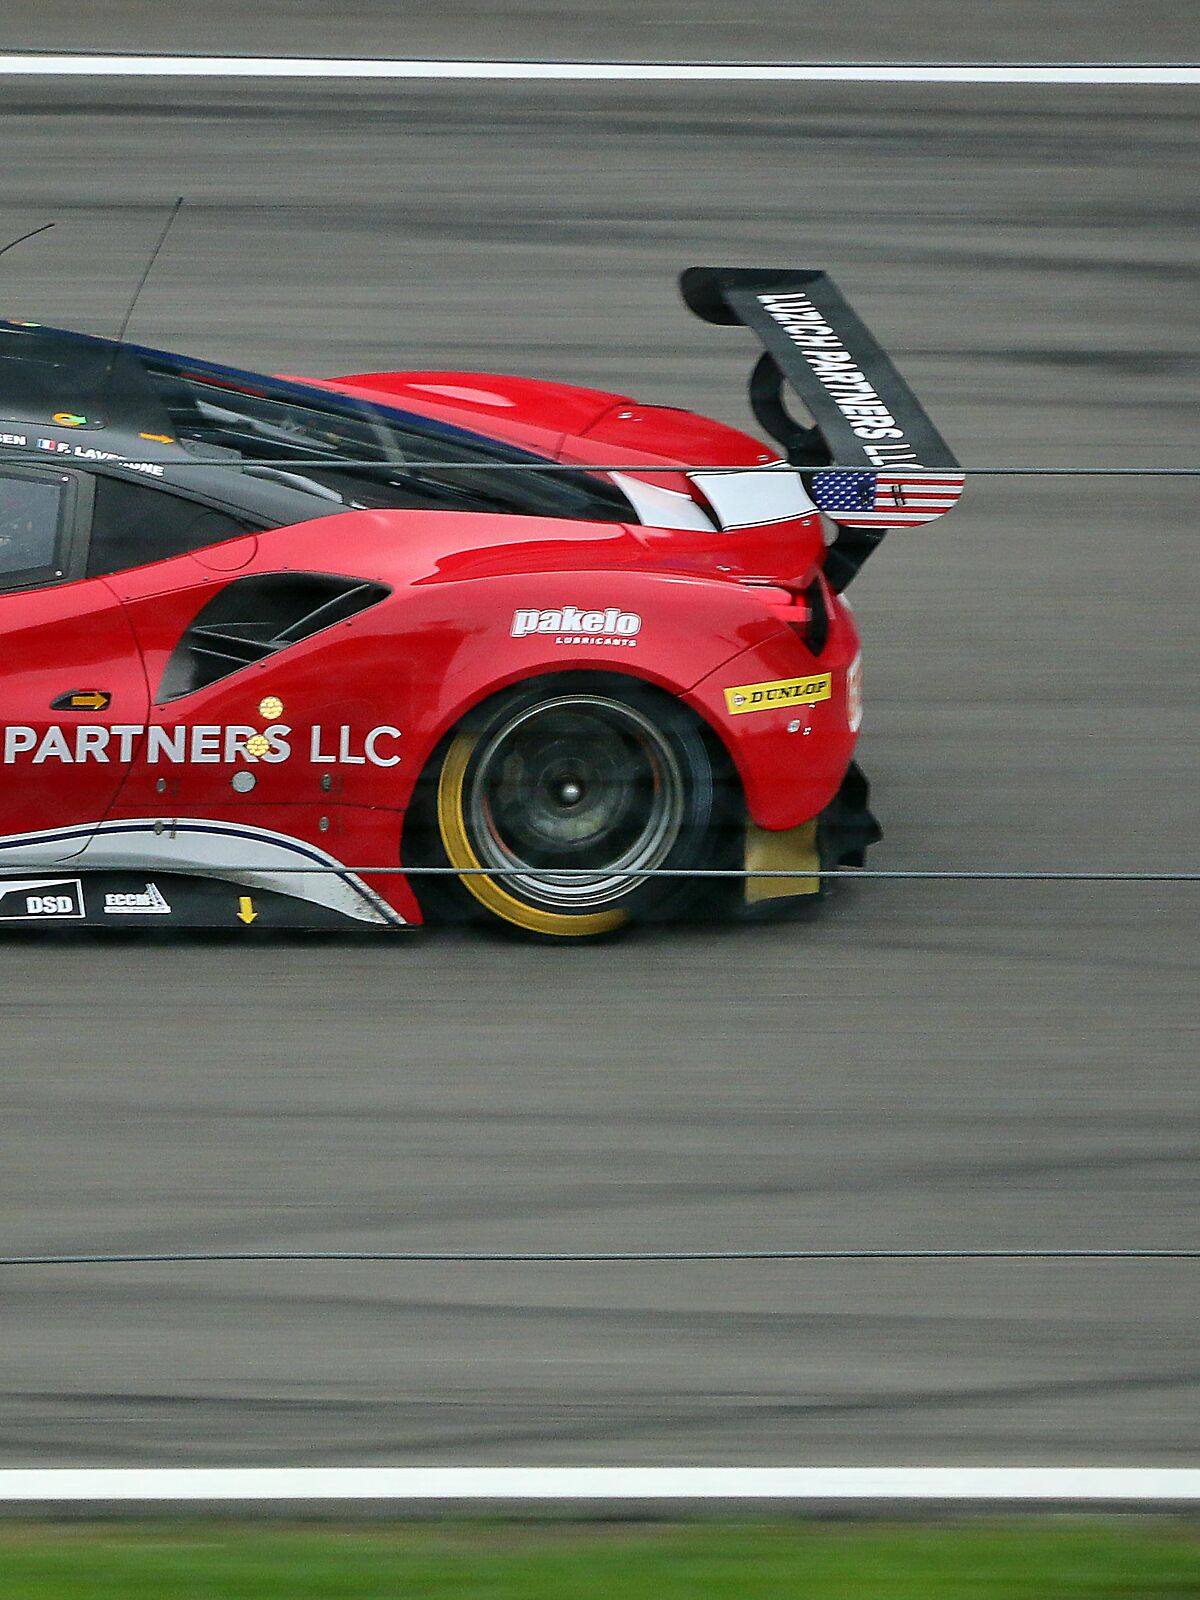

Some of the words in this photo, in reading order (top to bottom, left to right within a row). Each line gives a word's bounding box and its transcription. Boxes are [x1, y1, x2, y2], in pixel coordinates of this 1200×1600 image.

[756, 291, 844, 348] LUZICH
[801, 350, 904, 440] PARTNERS
[511, 606, 642, 637] pakelo
[555, 636, 637, 648] LUBRICANTS
[749, 680, 828, 704] DUNLOP
[3, 724, 293, 764] PARTNERS
[309, 724, 403, 768] LLC
[25, 895, 74, 915] DSD
